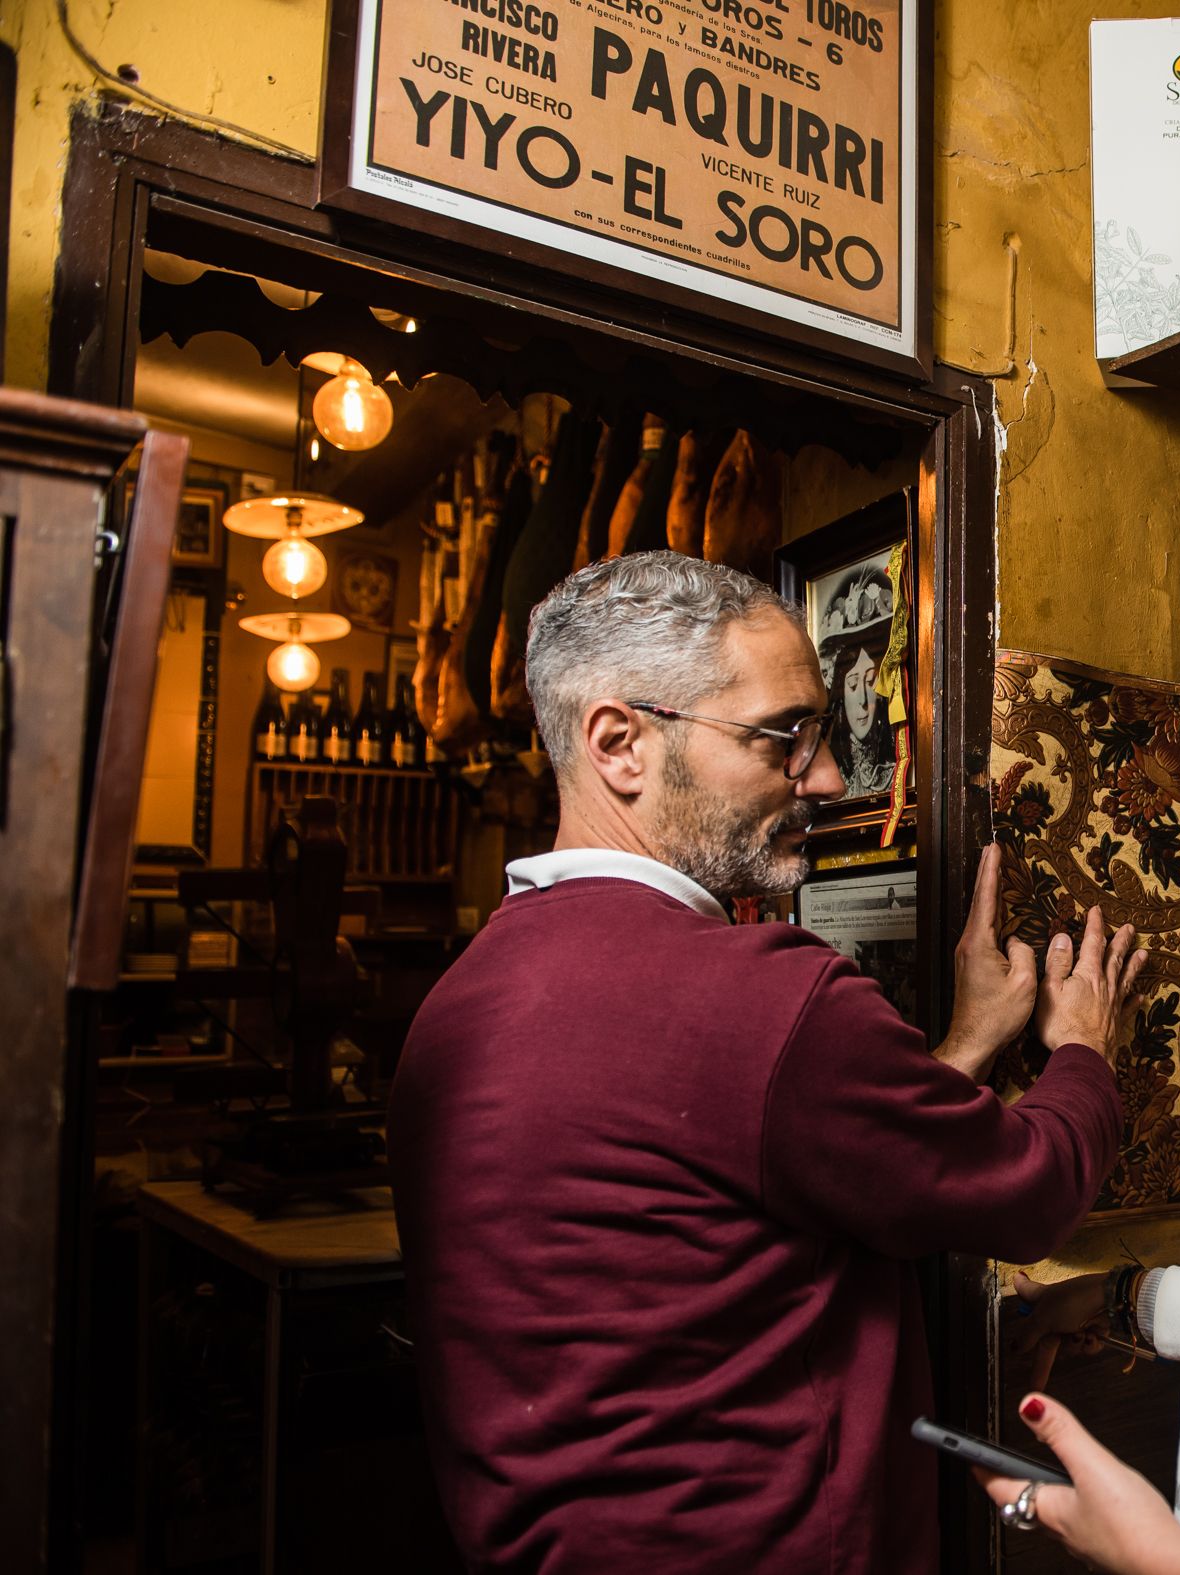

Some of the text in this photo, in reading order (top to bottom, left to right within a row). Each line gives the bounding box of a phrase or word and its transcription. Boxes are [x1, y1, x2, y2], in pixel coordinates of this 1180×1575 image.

[461, 19, 557, 83] RIVERA
[586, 3, 636, 31] Algeciras,
[640, 26, 662, 41] para
[666, 35, 680, 48] los
[684, 42, 722, 65] famosos
[725, 60, 761, 80] diestros
[596, 0, 822, 92] ERO y BANDRES
[687, 0, 784, 41] OROS
[826, 42, 844, 66] 6
[708, 16, 720, 27] de
[723, 22, 737, 34] los
[411, 51, 573, 120] JOSE CUBERO
[590, 26, 884, 205] PAQUIRRI
[701, 153, 821, 210] VICENTE RUIZ
[573, 208, 593, 222] con
[597, 216, 615, 229] sus
[620, 223, 703, 256] correspondientes
[706, 250, 751, 271] cuadrillas
[714, 189, 884, 292] SORO
